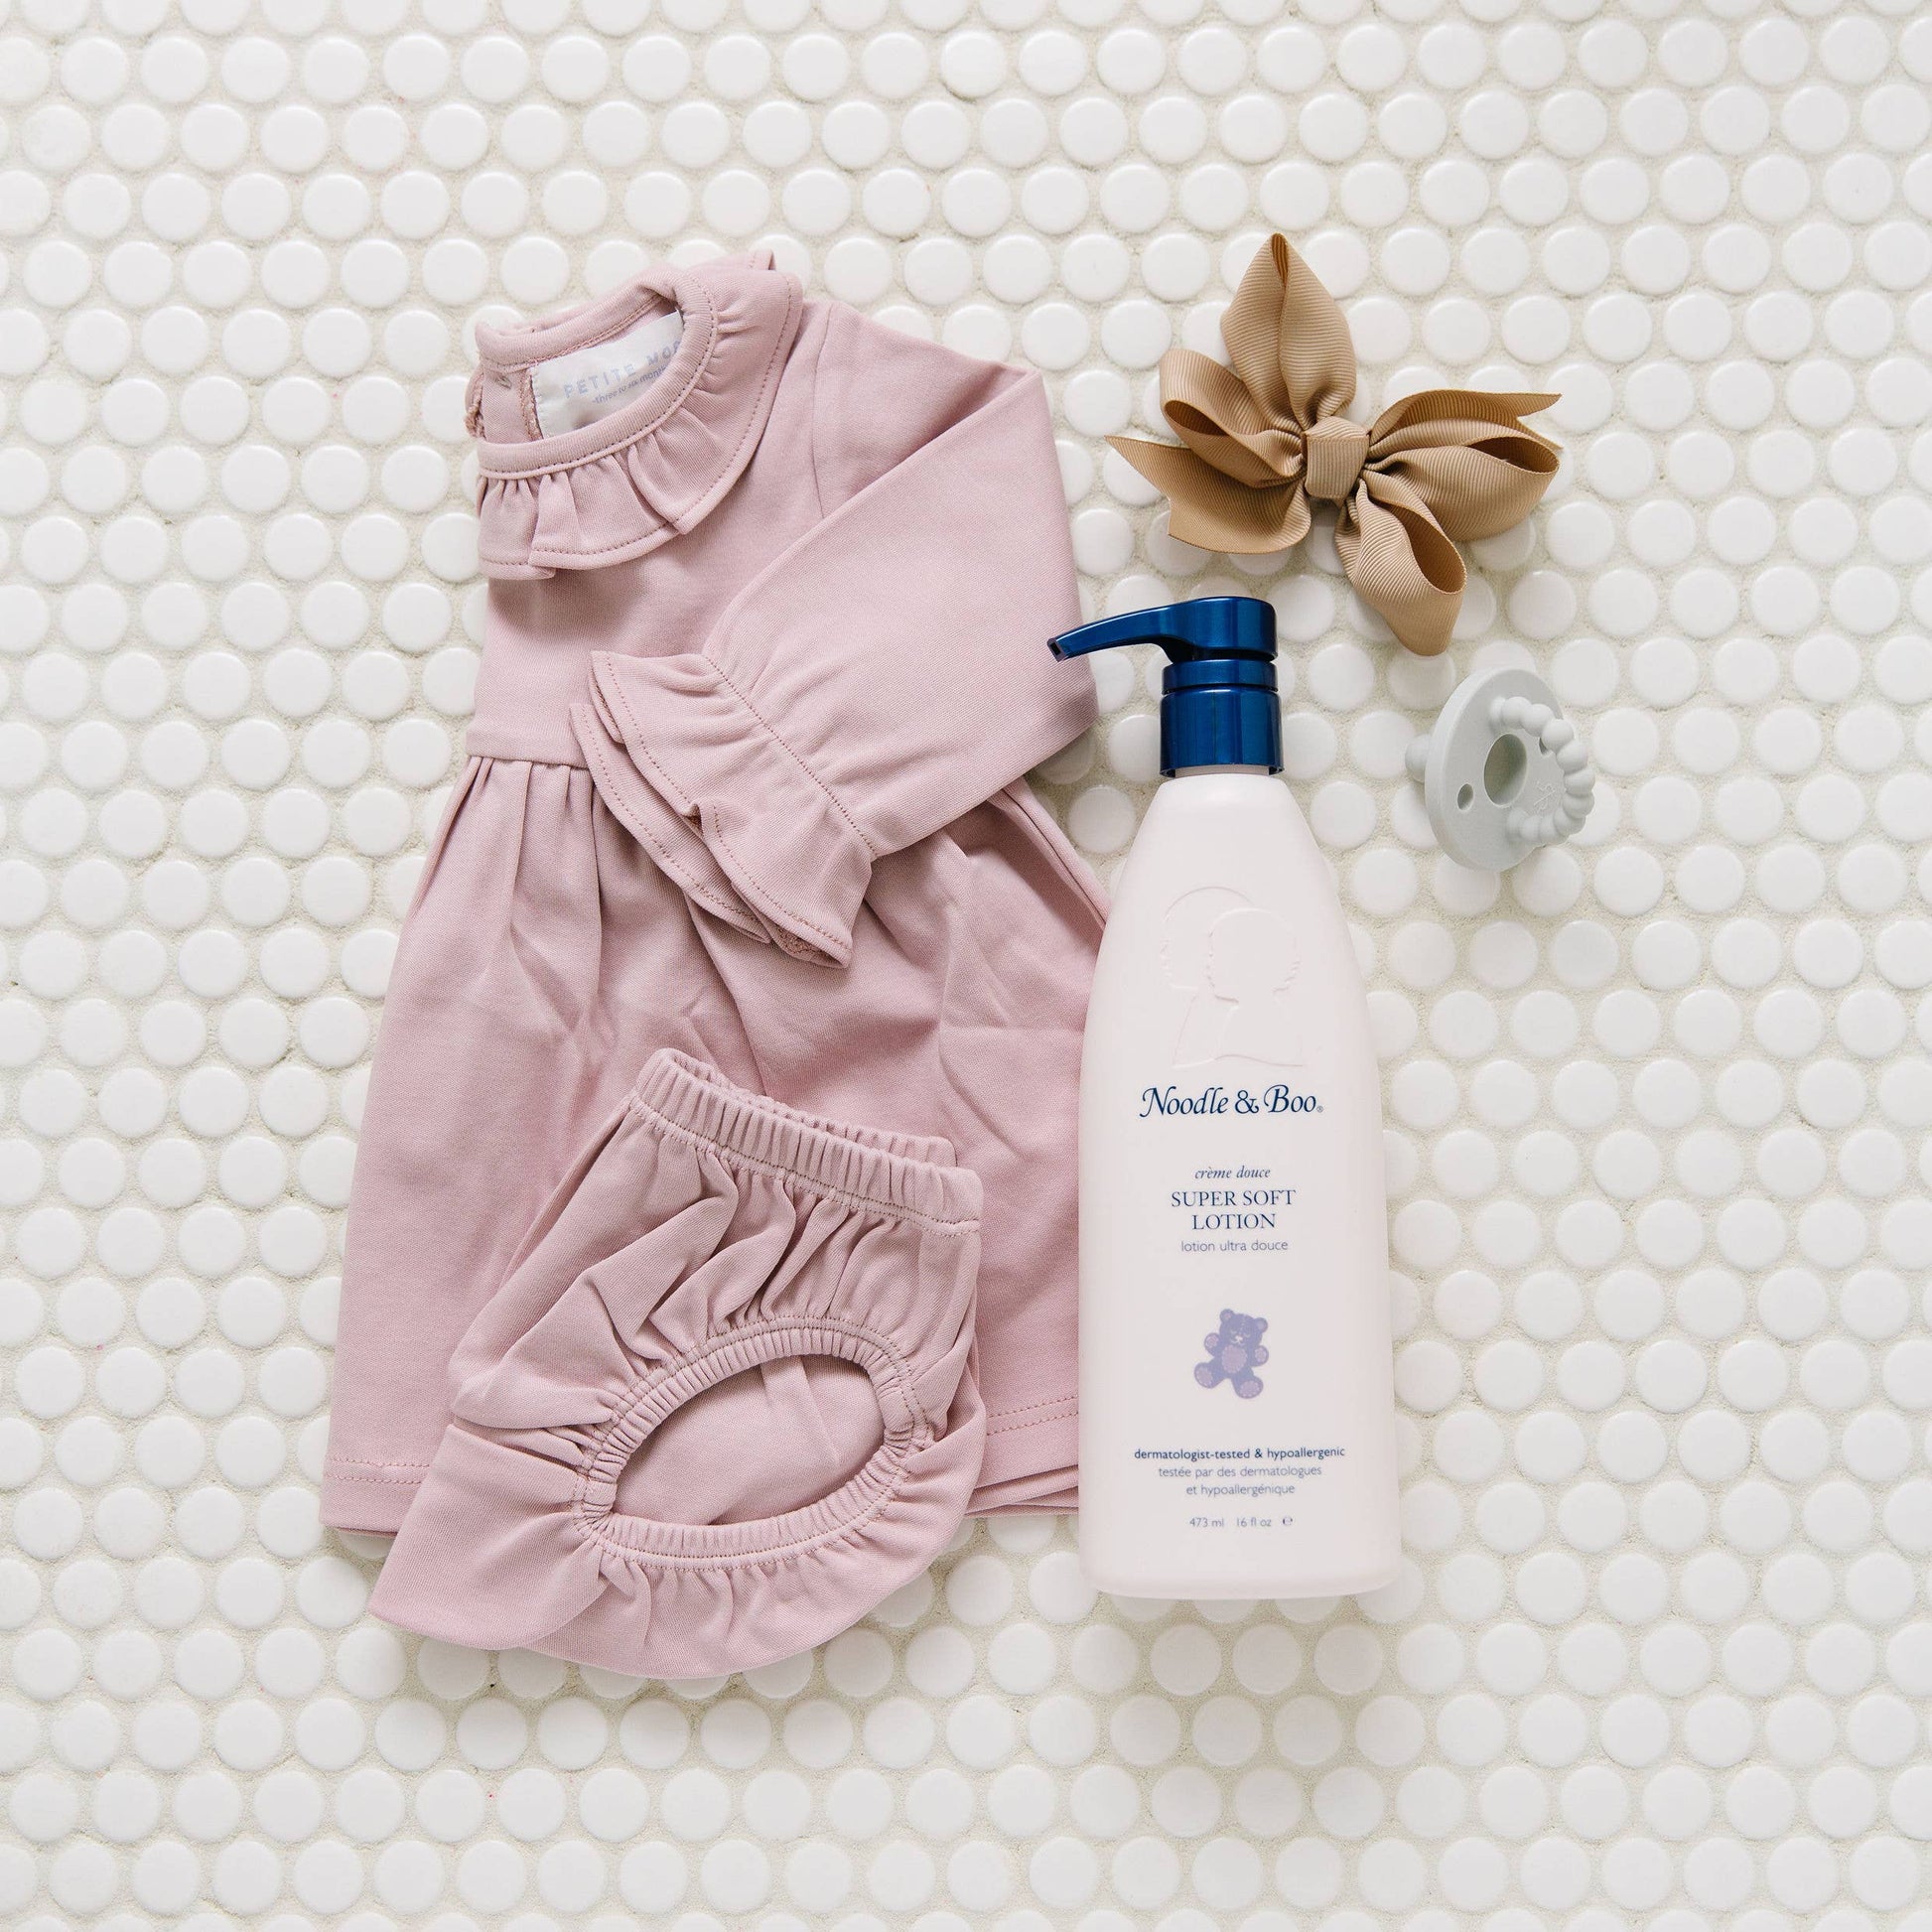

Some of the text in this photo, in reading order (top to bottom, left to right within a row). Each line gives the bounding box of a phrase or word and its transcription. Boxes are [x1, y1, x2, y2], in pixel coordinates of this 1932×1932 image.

[563, 363, 636, 399] PETITE
[1139, 1086, 1229, 1118] Noodle
[1234, 1090, 1259, 1114] &
[1194, 1165, 1271, 1179] crème douce
[1172, 1188, 1296, 1207] SUPER SOFT
[1191, 1213, 1276, 1230] LOTION
[1180, 1239, 1289, 1252] lotion ultra douce
[1134, 1447, 1346, 1462] dermatologist-tested & hypoallergenic
[1158, 1464, 1322, 1479] testée par des dermatologues
[1185, 1484, 1296, 1497] et hypoallergénique
[1189, 1517, 1208, 1528] 473
[1211, 1517, 1224, 1527] ml
[1237, 1517, 1247, 1527] 16
[1250, 1517, 1257, 1527] fl
[1260, 1518, 1272, 1527] oz
